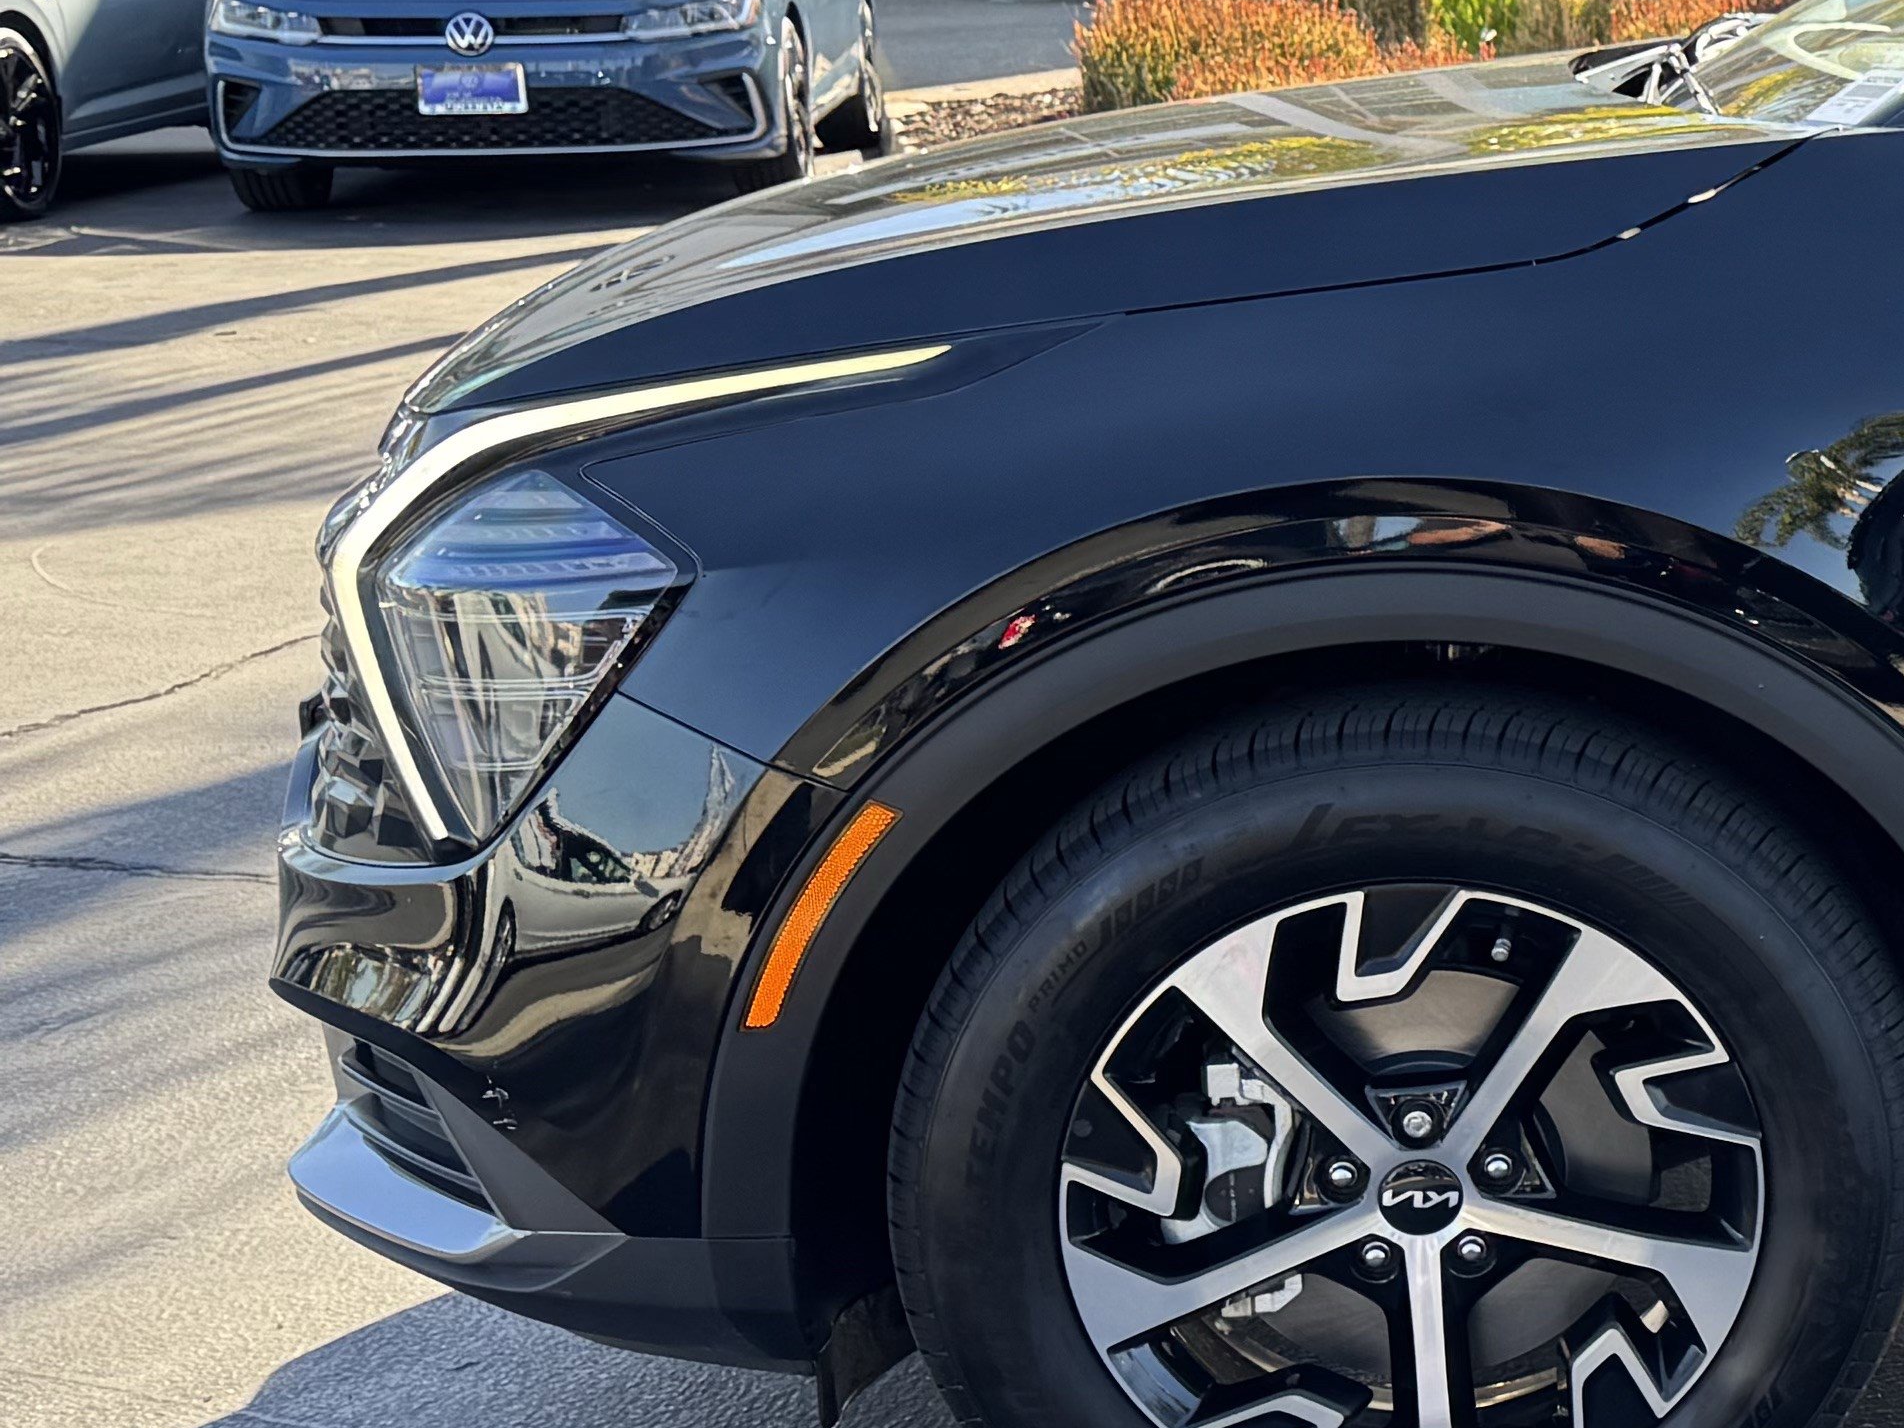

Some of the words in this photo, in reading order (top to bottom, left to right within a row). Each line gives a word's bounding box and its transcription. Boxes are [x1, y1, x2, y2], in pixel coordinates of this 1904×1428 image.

[446, 12, 494, 57] VW
[965, 1019, 1036, 1190] TEMPO
[1028, 940, 1087, 1014] PRIMO
